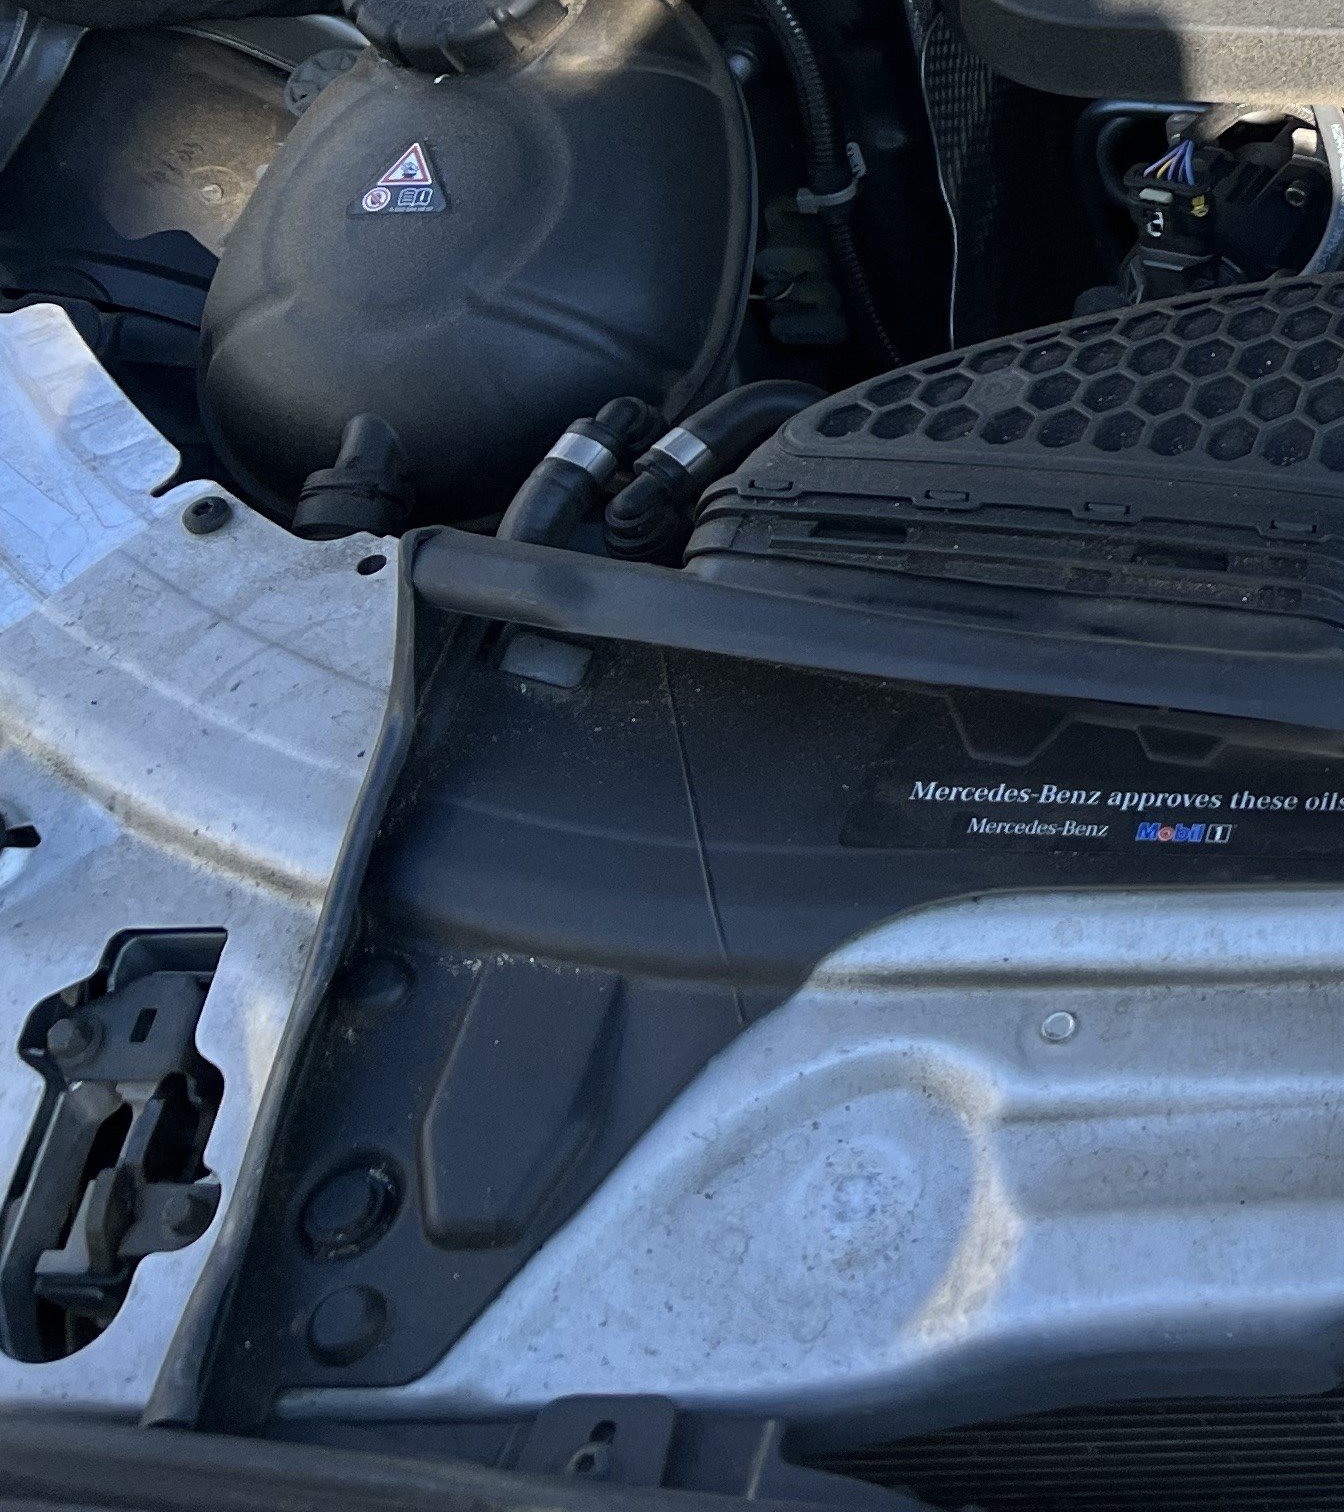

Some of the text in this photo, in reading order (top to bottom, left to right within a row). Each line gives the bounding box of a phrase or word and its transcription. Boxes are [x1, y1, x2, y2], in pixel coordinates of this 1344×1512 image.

[908, 781, 1102, 805] Mercedes-Benz
[1107, 790, 1223, 811] approves
[1229, 790, 1299, 810] these
[966, 817, 1110, 838] Mercedes-Benz
[1134, 822, 1206, 842] Mobil
